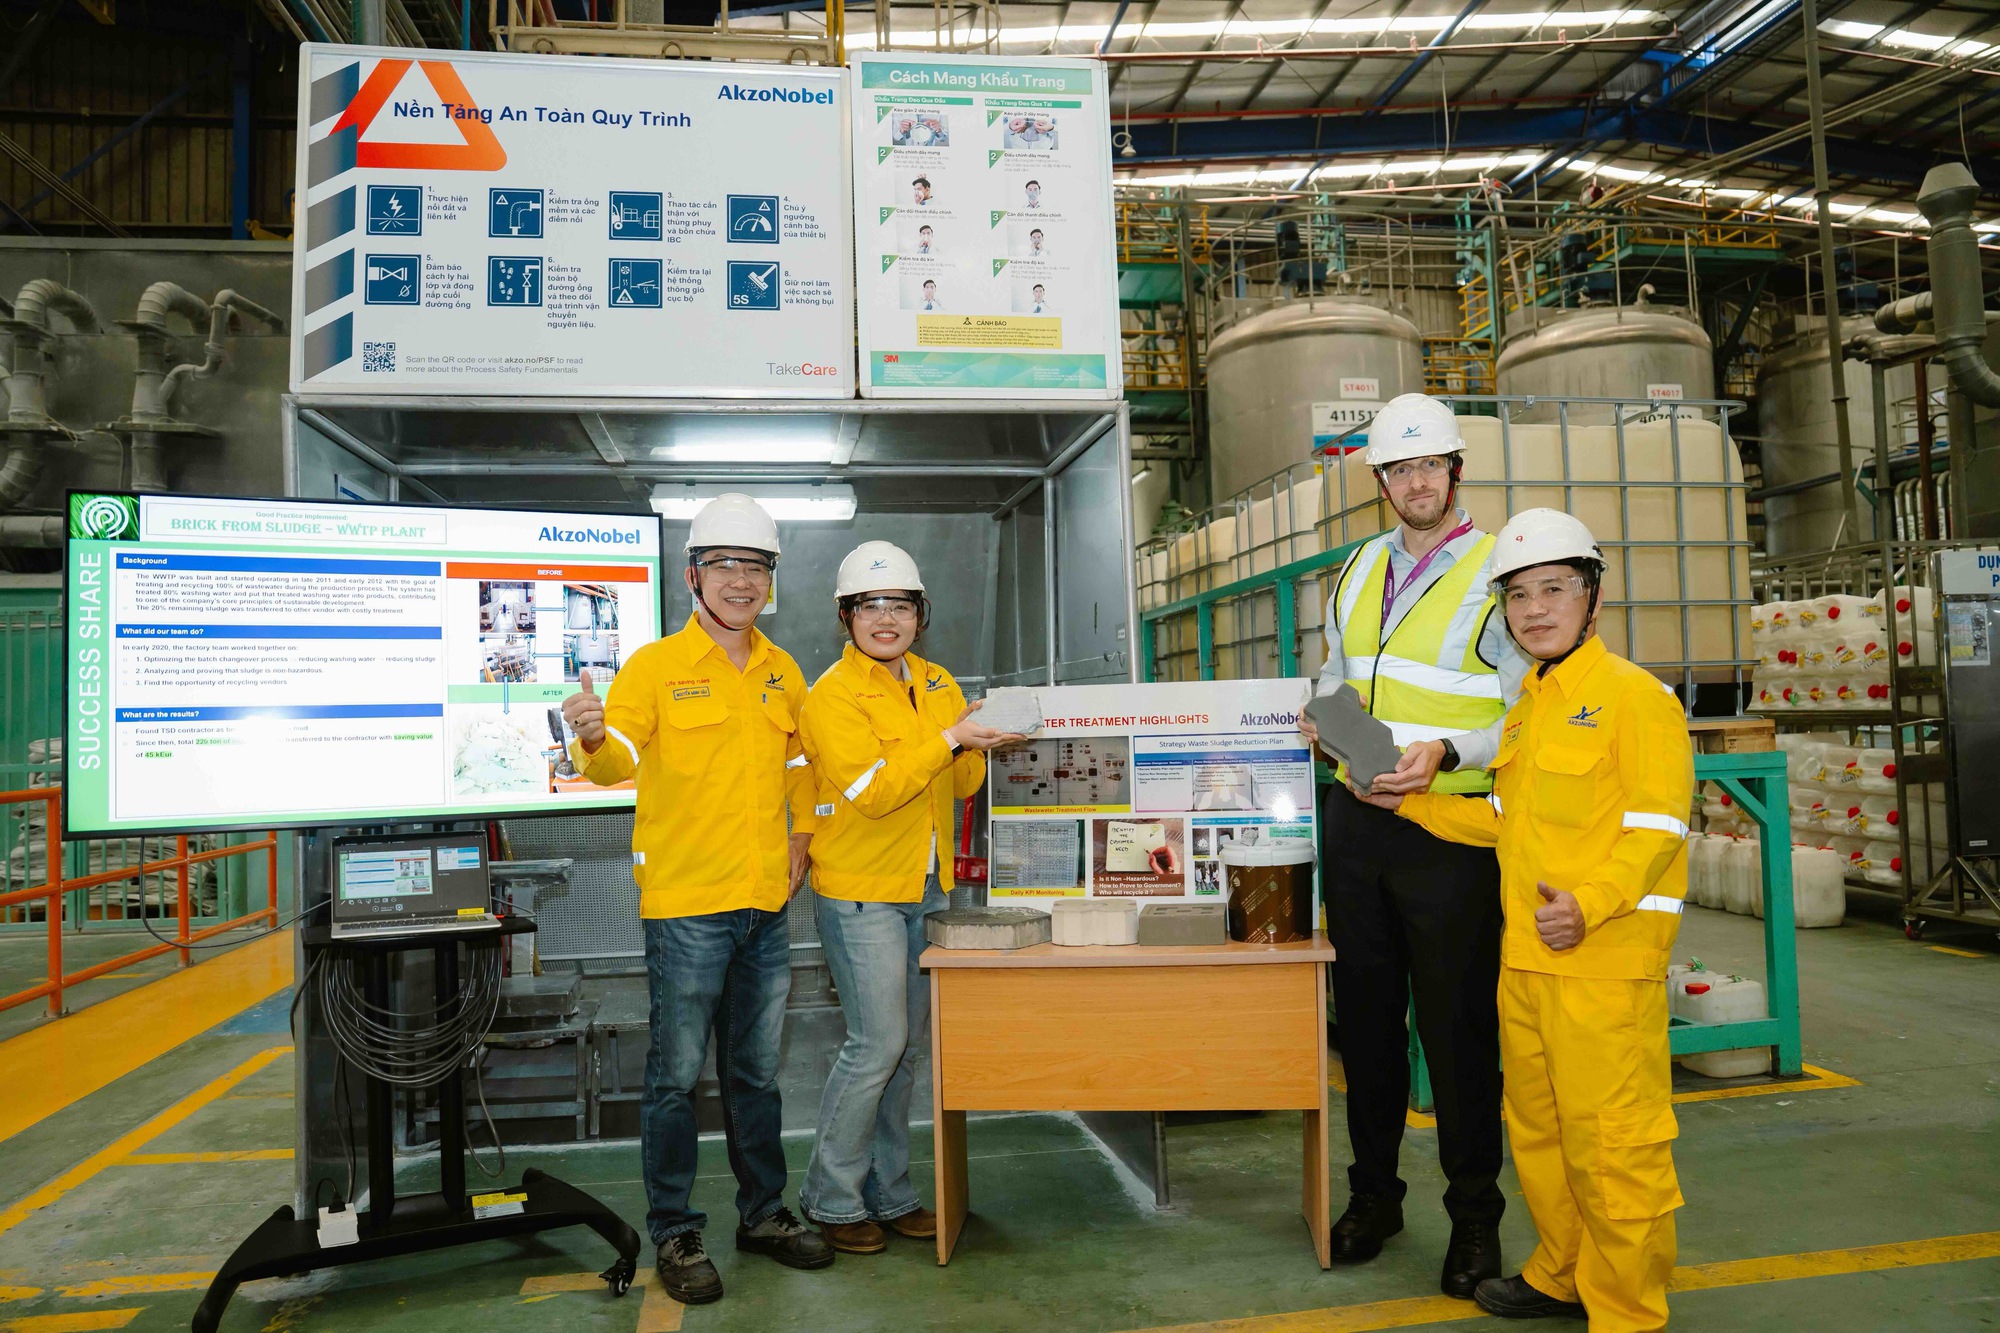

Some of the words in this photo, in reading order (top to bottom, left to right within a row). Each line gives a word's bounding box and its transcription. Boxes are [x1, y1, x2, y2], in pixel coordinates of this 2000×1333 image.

[889, 70, 930, 84] Cách
[933, 71, 977, 88] Mang
[980, 71, 1019, 87] Khẩu
[1022, 74, 1066, 91] Trang
[717, 84, 834, 106] AkzoNobel
[1000, 99, 1018, 107] Trang
[394, 99, 434, 118] Nền
[441, 103, 492, 124] Tảng
[499, 106, 527, 122] An
[534, 107, 585, 124] Toàn
[592, 109, 633, 129] Quy
[639, 111, 691, 127] Trình
[878, 108, 885, 116] 1
[988, 112, 993, 120] 1
[879, 149, 887, 157] 2
[990, 152, 997, 160] 2
[667, 191, 674, 199] 3.
[667, 200, 687, 208] Thao
[881, 209, 888, 217] 3
[992, 213, 999, 221] 3
[692, 219, 712, 228] phuy
[883, 257, 891, 265] 4
[994, 261, 1001, 269] 4
[784, 288, 800, 296] việc
[732, 294, 750, 306] 5S
[795, 297, 820, 306] không
[822, 298, 834, 306] bụi
[405, 355, 426, 363] Scan
[441, 355, 455, 363] QR
[504, 356, 555, 364] akzo.no/PSF
[883, 354, 899, 363] 3M
[465, 365, 497, 373] Process
[498, 365, 523, 375] Safety
[524, 366, 578, 374] Fundamentals
[765, 361, 838, 377] TakeCare
[1344, 383, 1375, 392] ST4011
[1651, 389, 1680, 397] ST4017
[1330, 410, 1379, 422] 41151
[304, 513, 349, 521] Implemented:
[171, 519, 217, 530] BRICK
[222, 520, 262, 532] FROM
[265, 522, 321, 534] SLUDGE
[336, 523, 378, 536] WWTP
[381, 526, 426, 538] PLANT
[538, 526, 640, 544] AkzoNobel
[1515, 535, 1523, 543] 9
[123, 557, 168, 565] Background
[79, 552, 101, 639] SHARE
[122, 627, 142, 635] What
[78, 648, 101, 770] SUCCESS
[170, 710, 200, 718] results?
[1240, 711, 1300, 726] AkzoNob
[1042, 718, 1066, 728] TER
[1069, 716, 1136, 727] TREATMENT
[1139, 714, 1209, 725] HIGHLIGHTS
[1567, 719, 1598, 729] AkzoNobel
[1159, 741, 1187, 749] Strategy
[1210, 739, 1233, 747] Sludge
